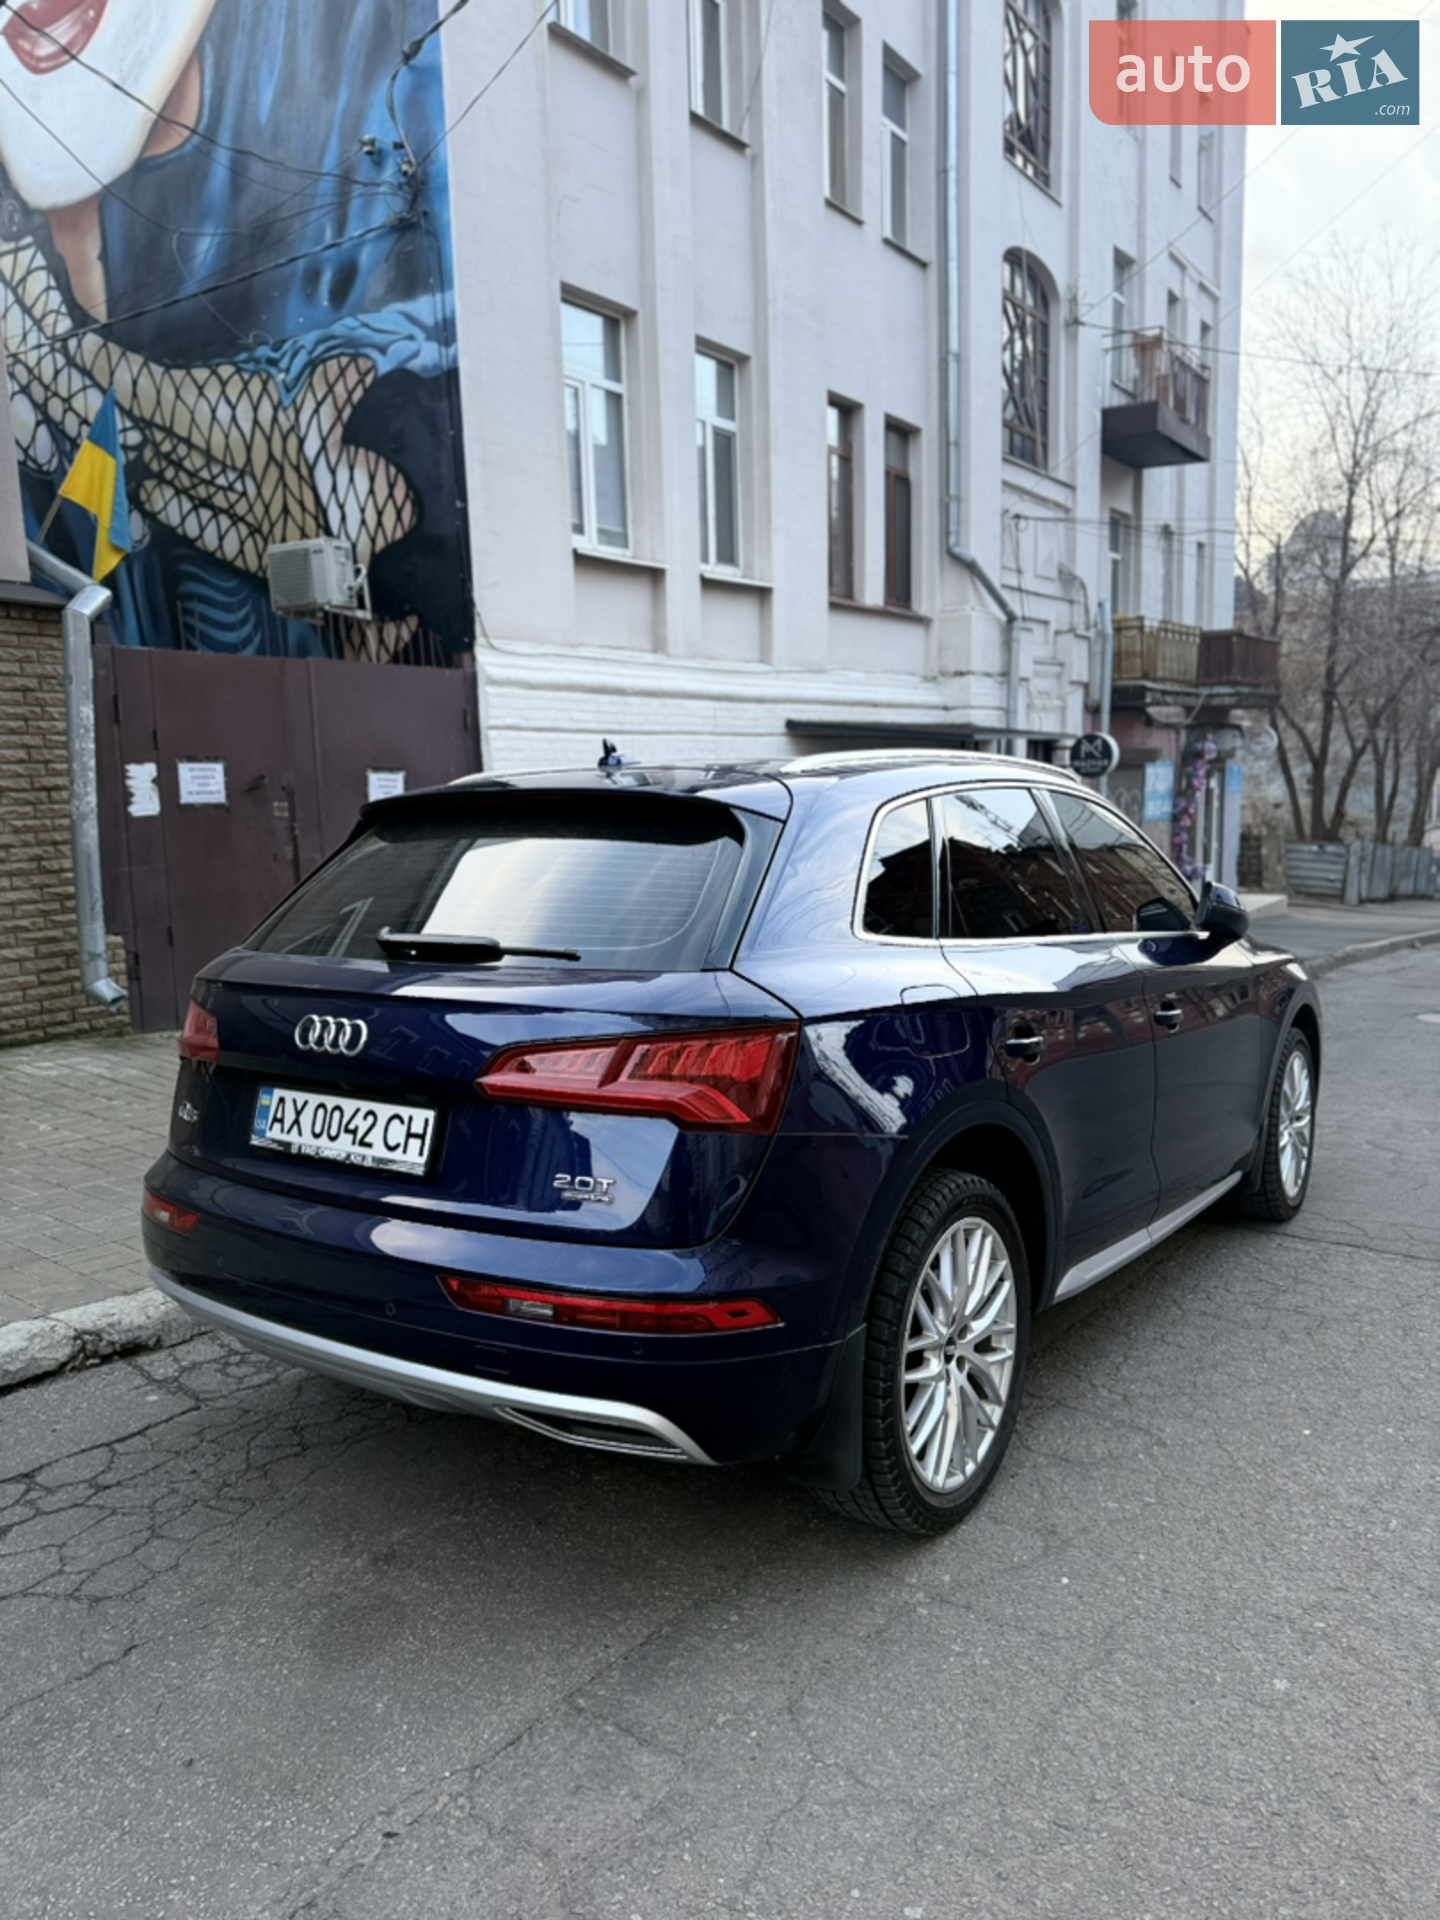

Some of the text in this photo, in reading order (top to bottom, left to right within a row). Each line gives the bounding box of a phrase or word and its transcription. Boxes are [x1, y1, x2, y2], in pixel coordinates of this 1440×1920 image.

[268, 1096, 309, 1137] AX
[311, 1102, 378, 1149] 0042
[382, 1113, 430, 1157] CH
